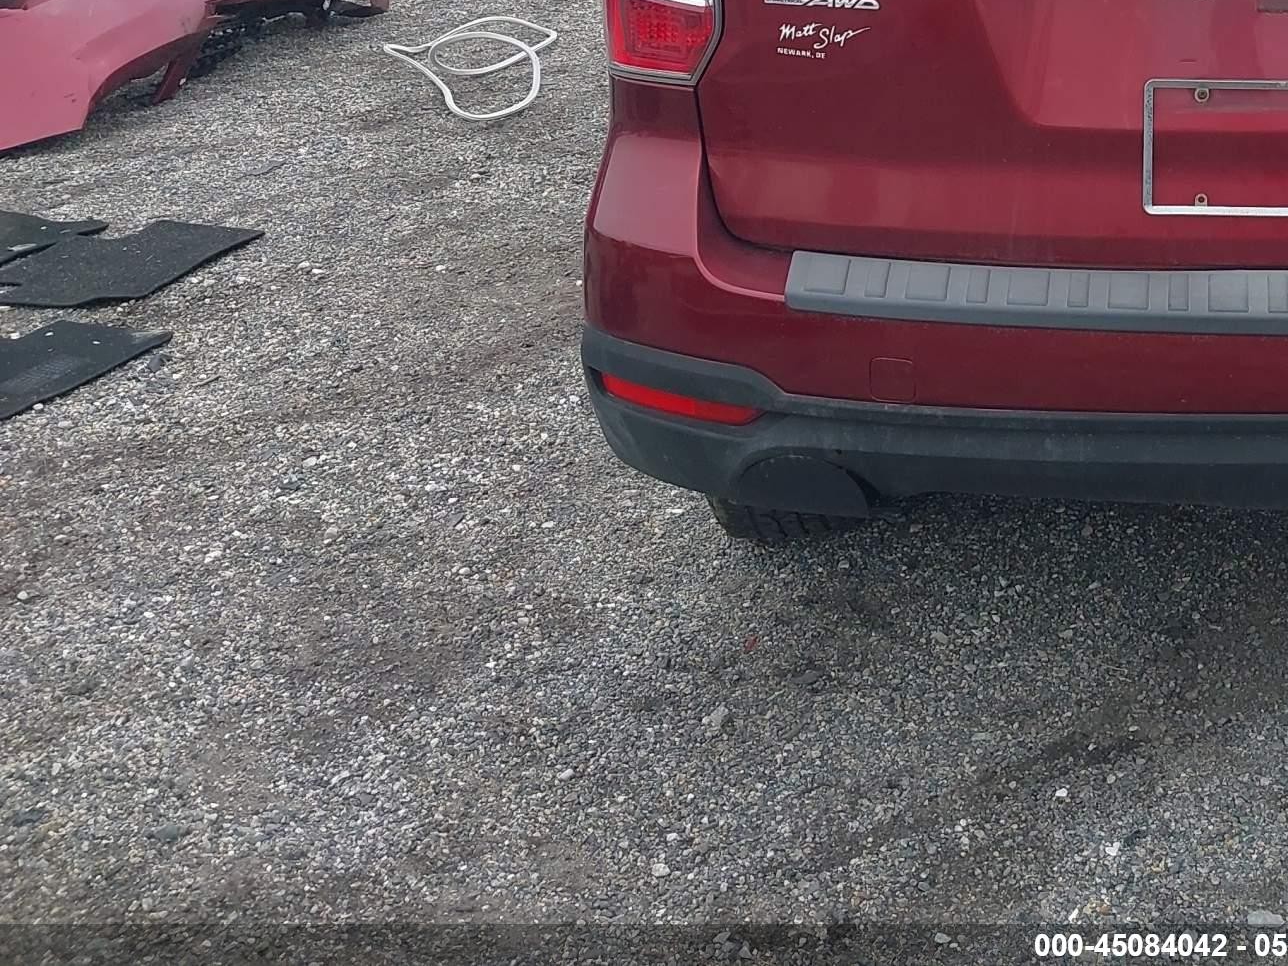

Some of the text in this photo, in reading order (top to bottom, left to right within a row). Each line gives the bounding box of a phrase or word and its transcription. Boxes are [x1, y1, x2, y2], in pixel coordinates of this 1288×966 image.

[779, 23, 871, 50] Matt Slap
[777, 47, 814, 59] NEWARK,
